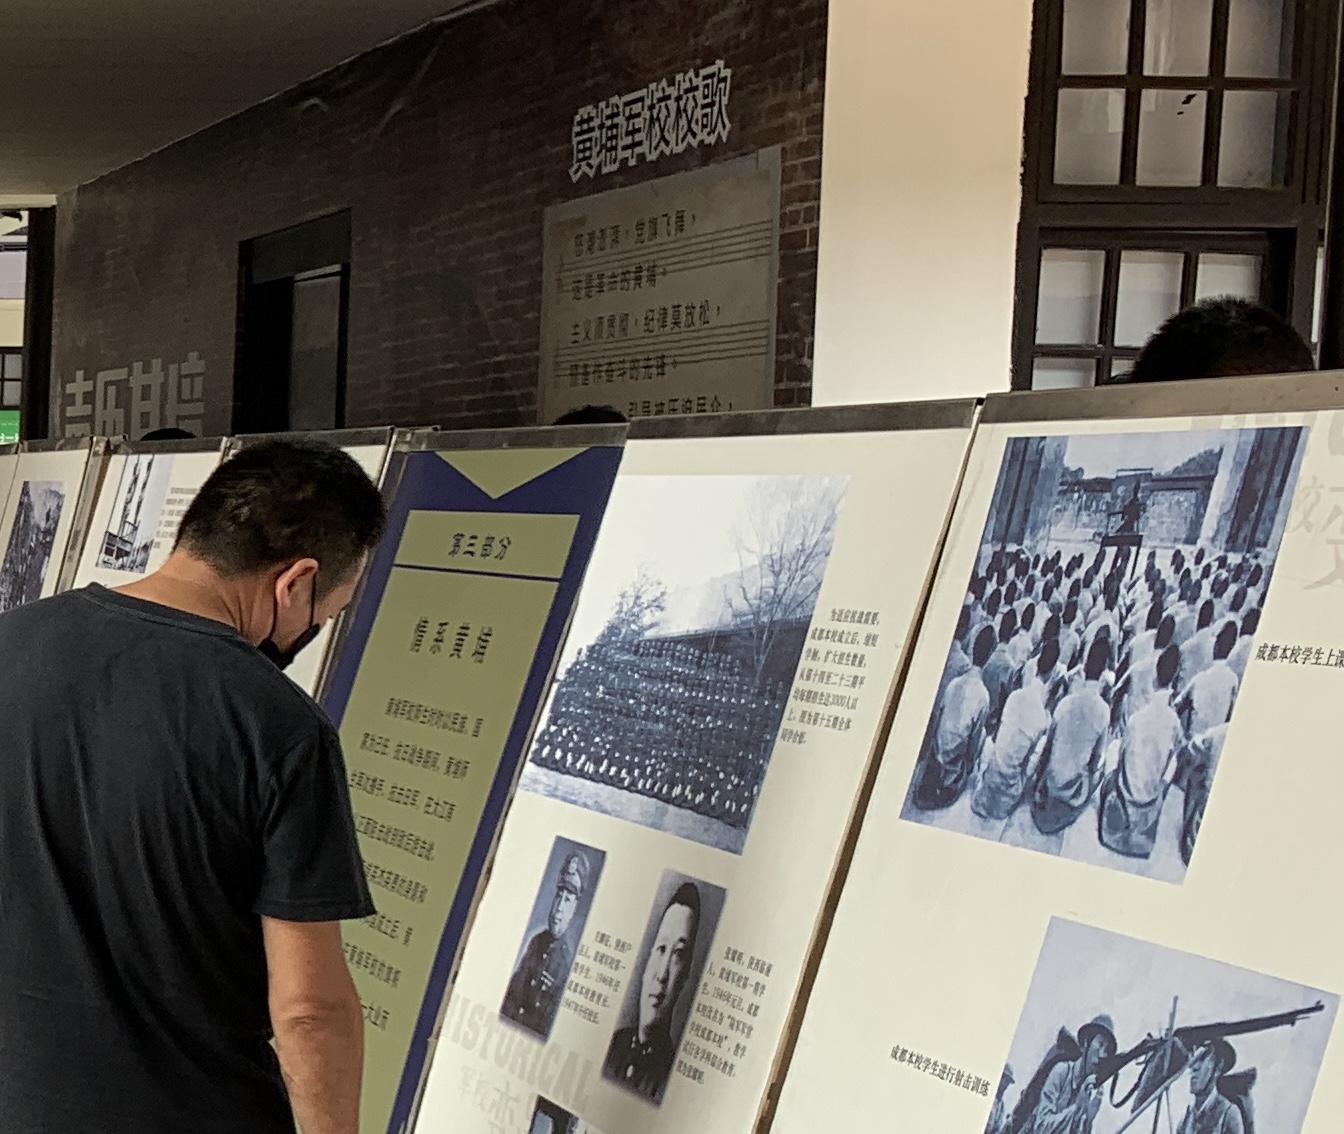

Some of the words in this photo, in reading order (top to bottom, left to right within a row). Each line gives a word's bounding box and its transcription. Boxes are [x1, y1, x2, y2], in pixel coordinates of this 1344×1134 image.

[568, 59, 732, 183] 黄埔军校校歌
[890, 1044, 991, 1097] 成都本校学生进行射击训练
